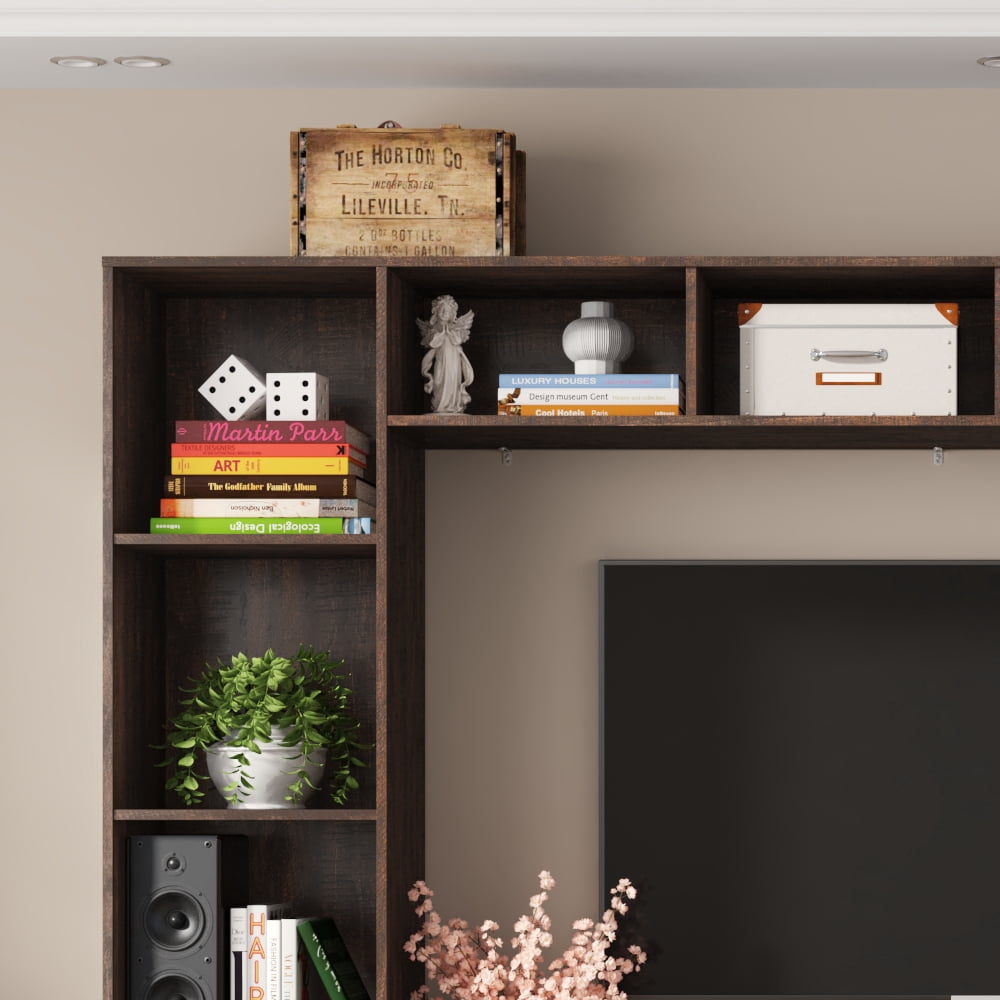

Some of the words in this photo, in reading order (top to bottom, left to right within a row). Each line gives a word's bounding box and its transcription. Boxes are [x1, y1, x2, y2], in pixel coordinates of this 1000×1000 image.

[335, 150, 364, 171] THE
[372, 144, 435, 165] HORTON
[391, 229, 442, 242] BOTTLES
[344, 245, 397, 256] CONTAINS
[414, 246, 455, 256] GALLON
[529, 393, 555, 402] Design
[590, 393, 608, 401] Gent
[207, 423, 282, 441] Martin
[289, 423, 342, 441] Parr
[213, 460, 240, 472] ART
[208, 482, 223, 491] The
[225, 482, 263, 491] Godfather
[267, 483, 292, 492] Family
[293, 483, 317, 491] Album
[229, 522, 265, 533] Design
[269, 522, 320, 533] Ecological
[270, 973, 277, 981] IN
